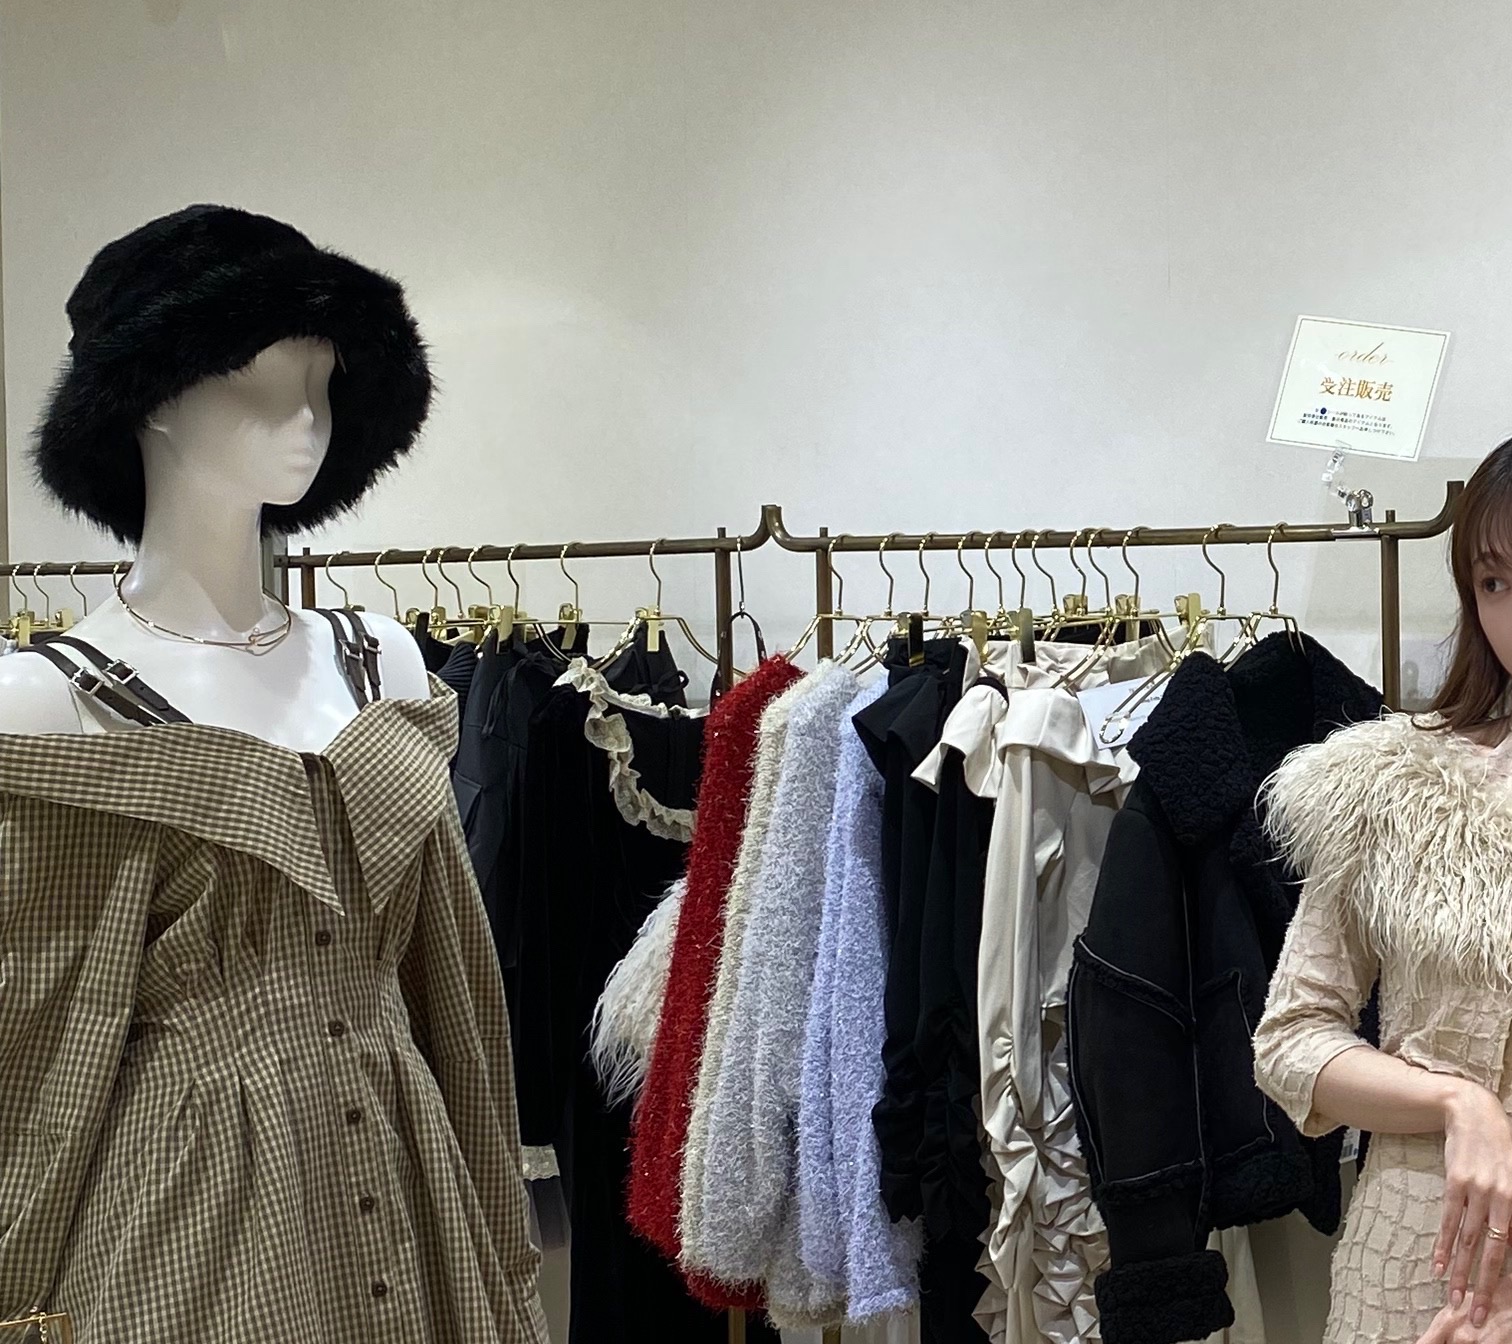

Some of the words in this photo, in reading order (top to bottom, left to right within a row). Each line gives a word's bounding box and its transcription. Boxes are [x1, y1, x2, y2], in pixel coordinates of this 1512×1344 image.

[1336, 341, 1393, 366] order
[1318, 376, 1395, 403] 受注販売
